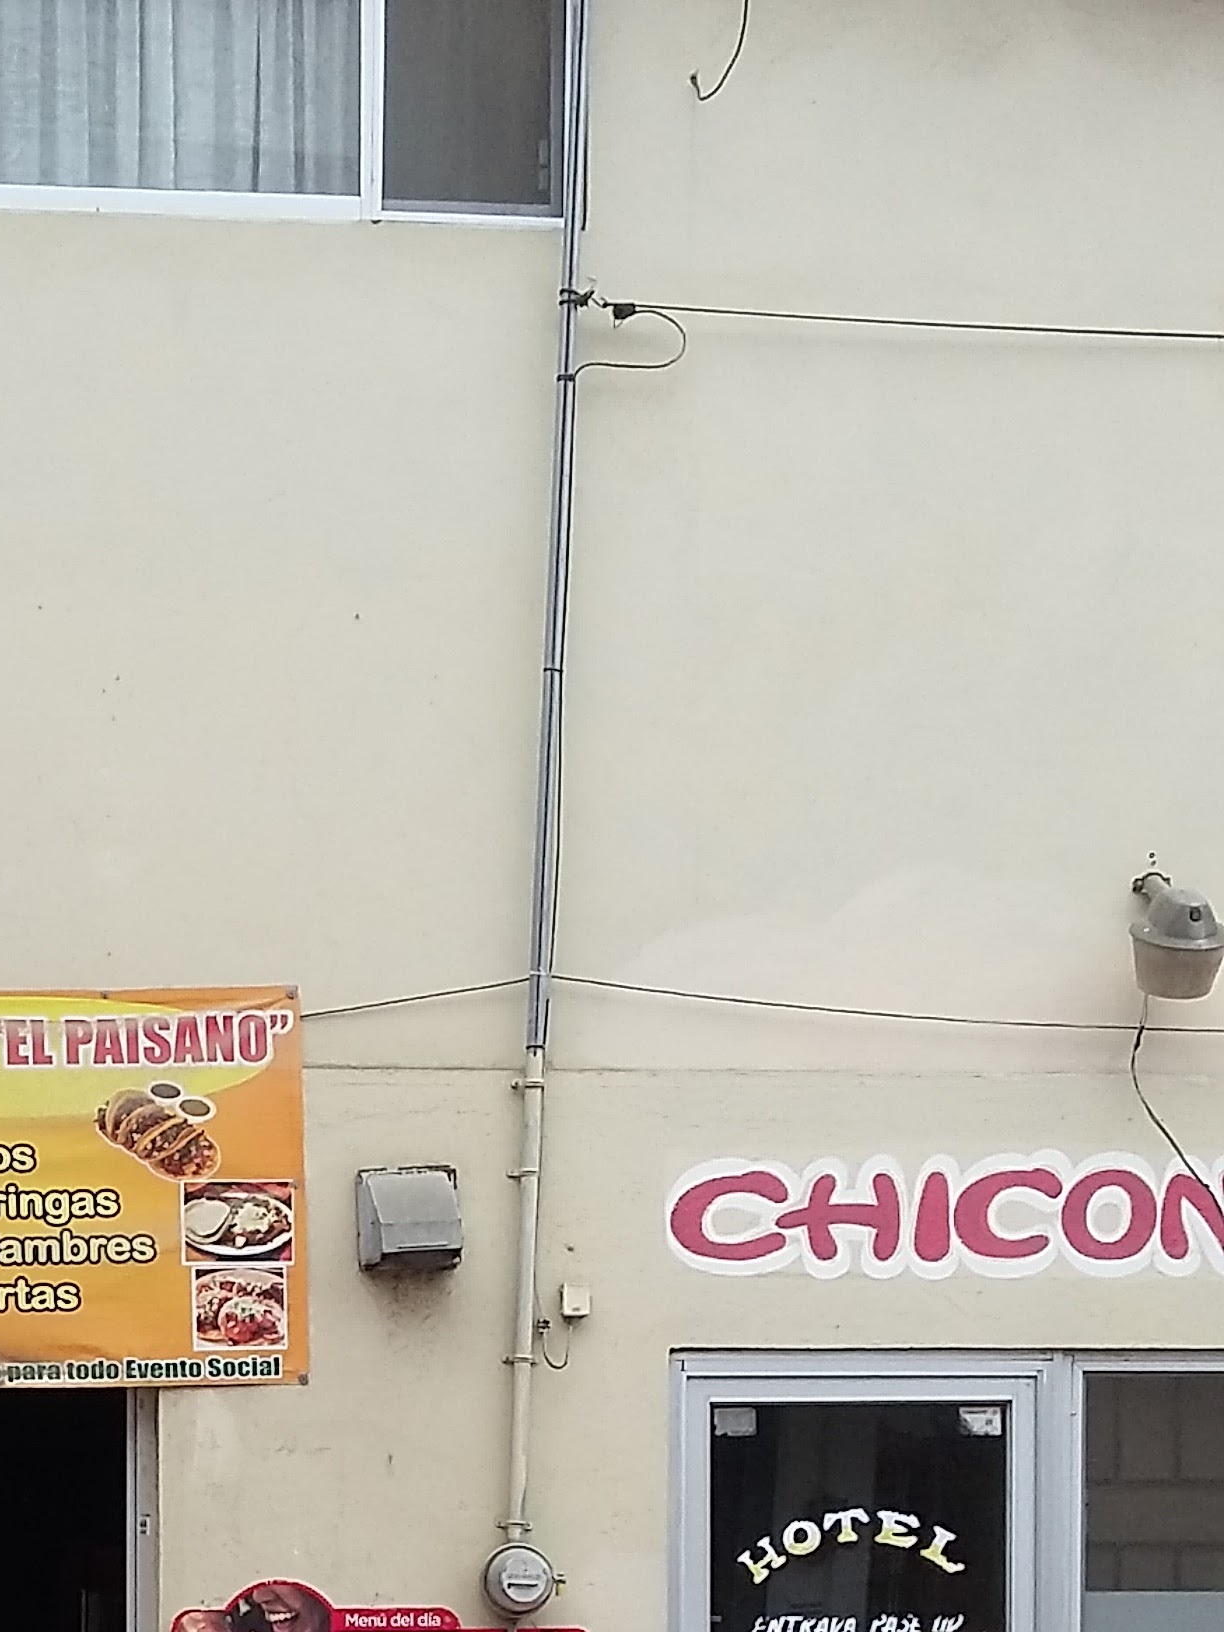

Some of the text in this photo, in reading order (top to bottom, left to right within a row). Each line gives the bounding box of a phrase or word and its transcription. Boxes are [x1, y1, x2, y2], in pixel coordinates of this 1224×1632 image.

[7, 1363, 62, 1383] para
[67, 1360, 119, 1381] todo
[126, 1359, 202, 1379] Evento
[208, 1356, 280, 1377] Social
[737, 1507, 966, 1585] HOTEL
[345, 1612, 387, 1627] Menú
[390, 1612, 414, 1627] del
